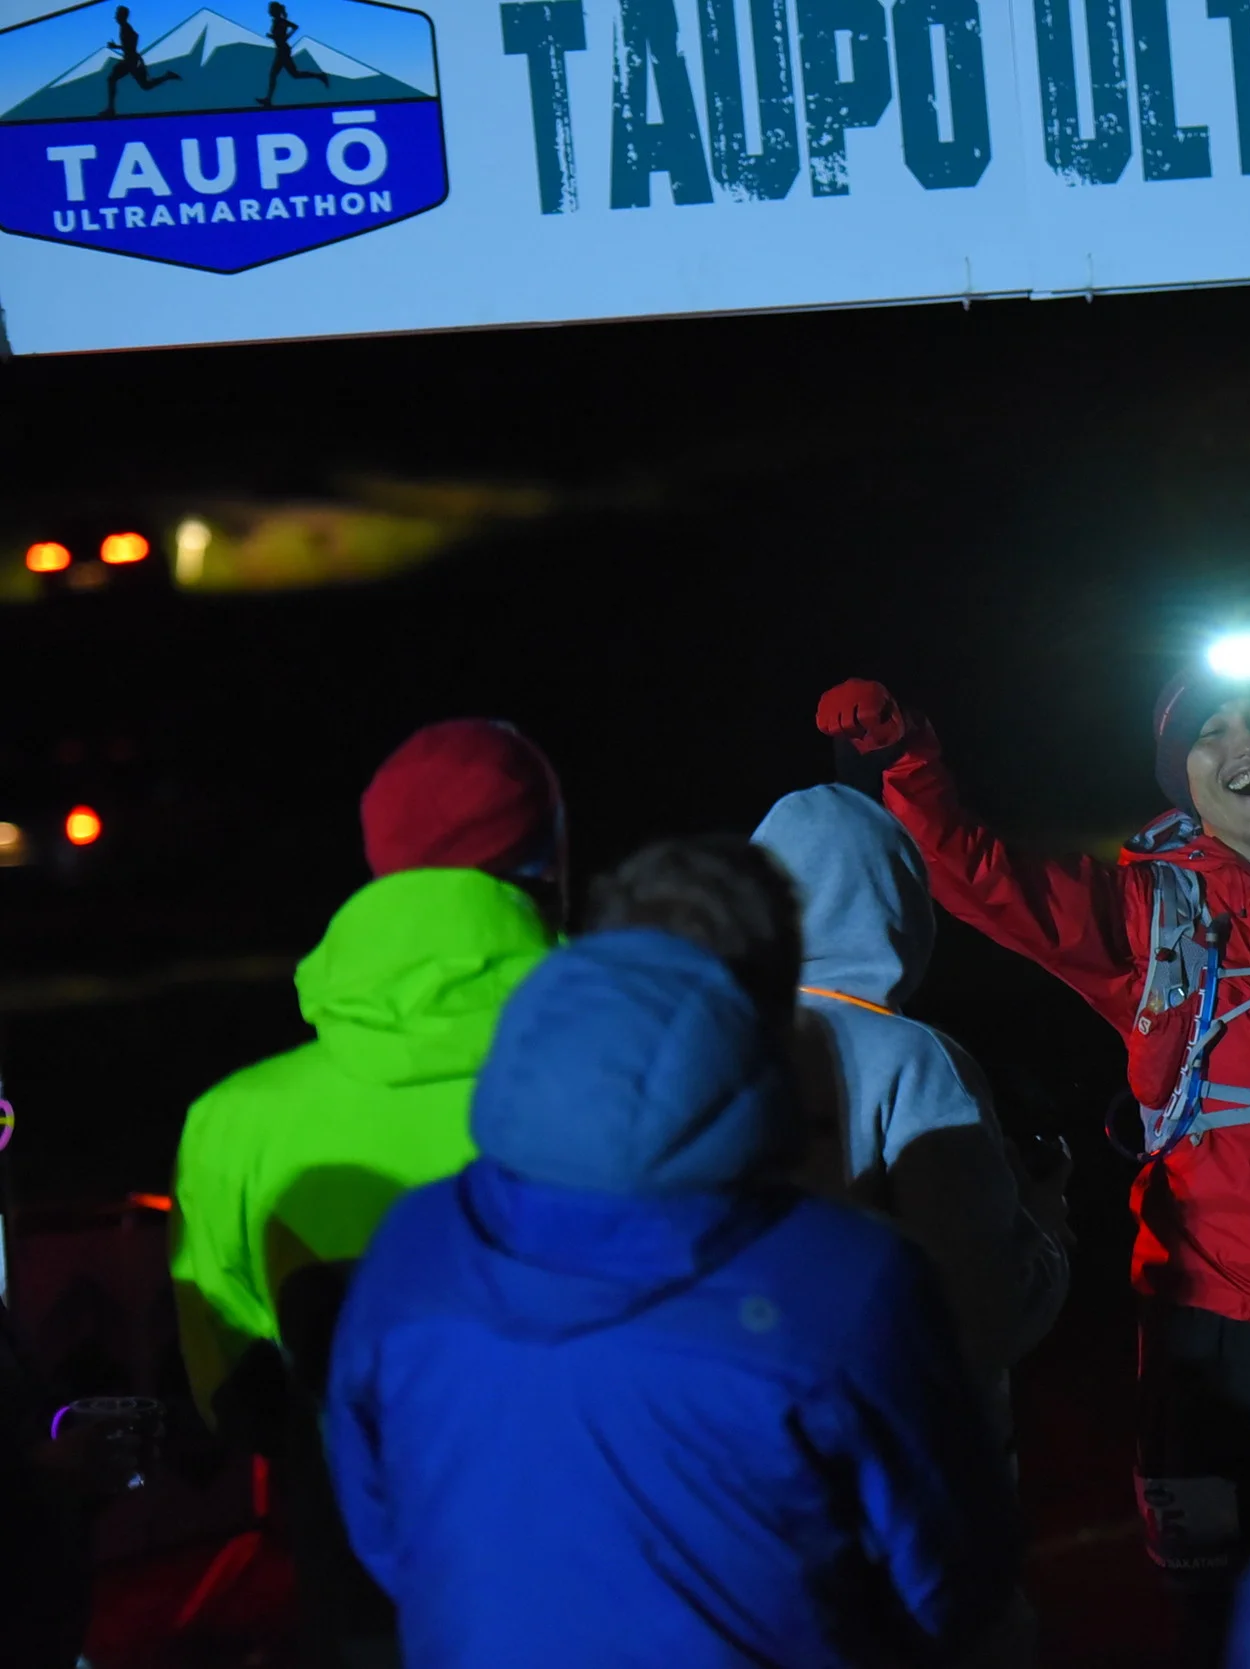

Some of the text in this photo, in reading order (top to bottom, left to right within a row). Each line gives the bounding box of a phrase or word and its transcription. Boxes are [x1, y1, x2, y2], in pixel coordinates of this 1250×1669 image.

[500, 0, 992, 215] TAUPO
[46, 110, 389, 202] TAUPŌ
[53, 190, 393, 233] ULTRAMARATHON
